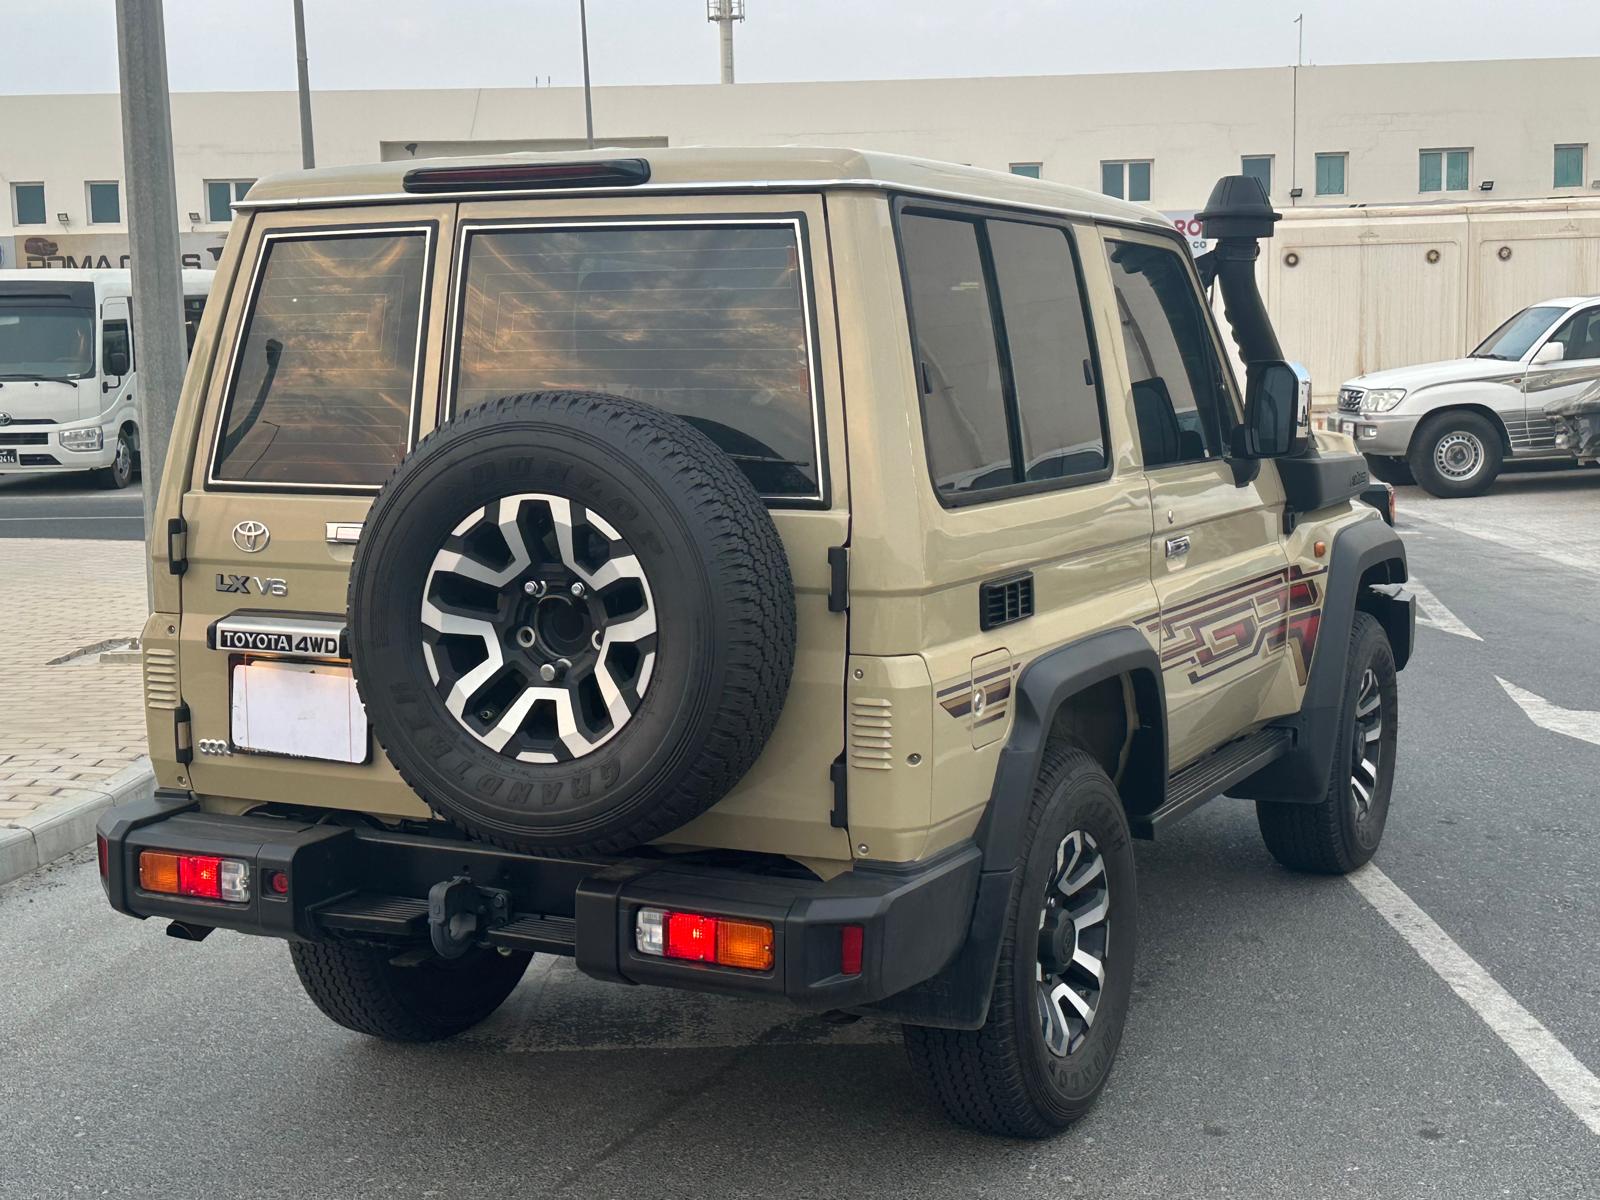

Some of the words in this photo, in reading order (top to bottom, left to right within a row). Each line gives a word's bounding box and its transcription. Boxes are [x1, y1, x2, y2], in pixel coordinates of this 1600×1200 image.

[216, 573, 250, 594] LX
[253, 576, 287, 596] V6
[223, 632, 290, 651] TOYOTA
[295, 636, 338, 654] 4WD
